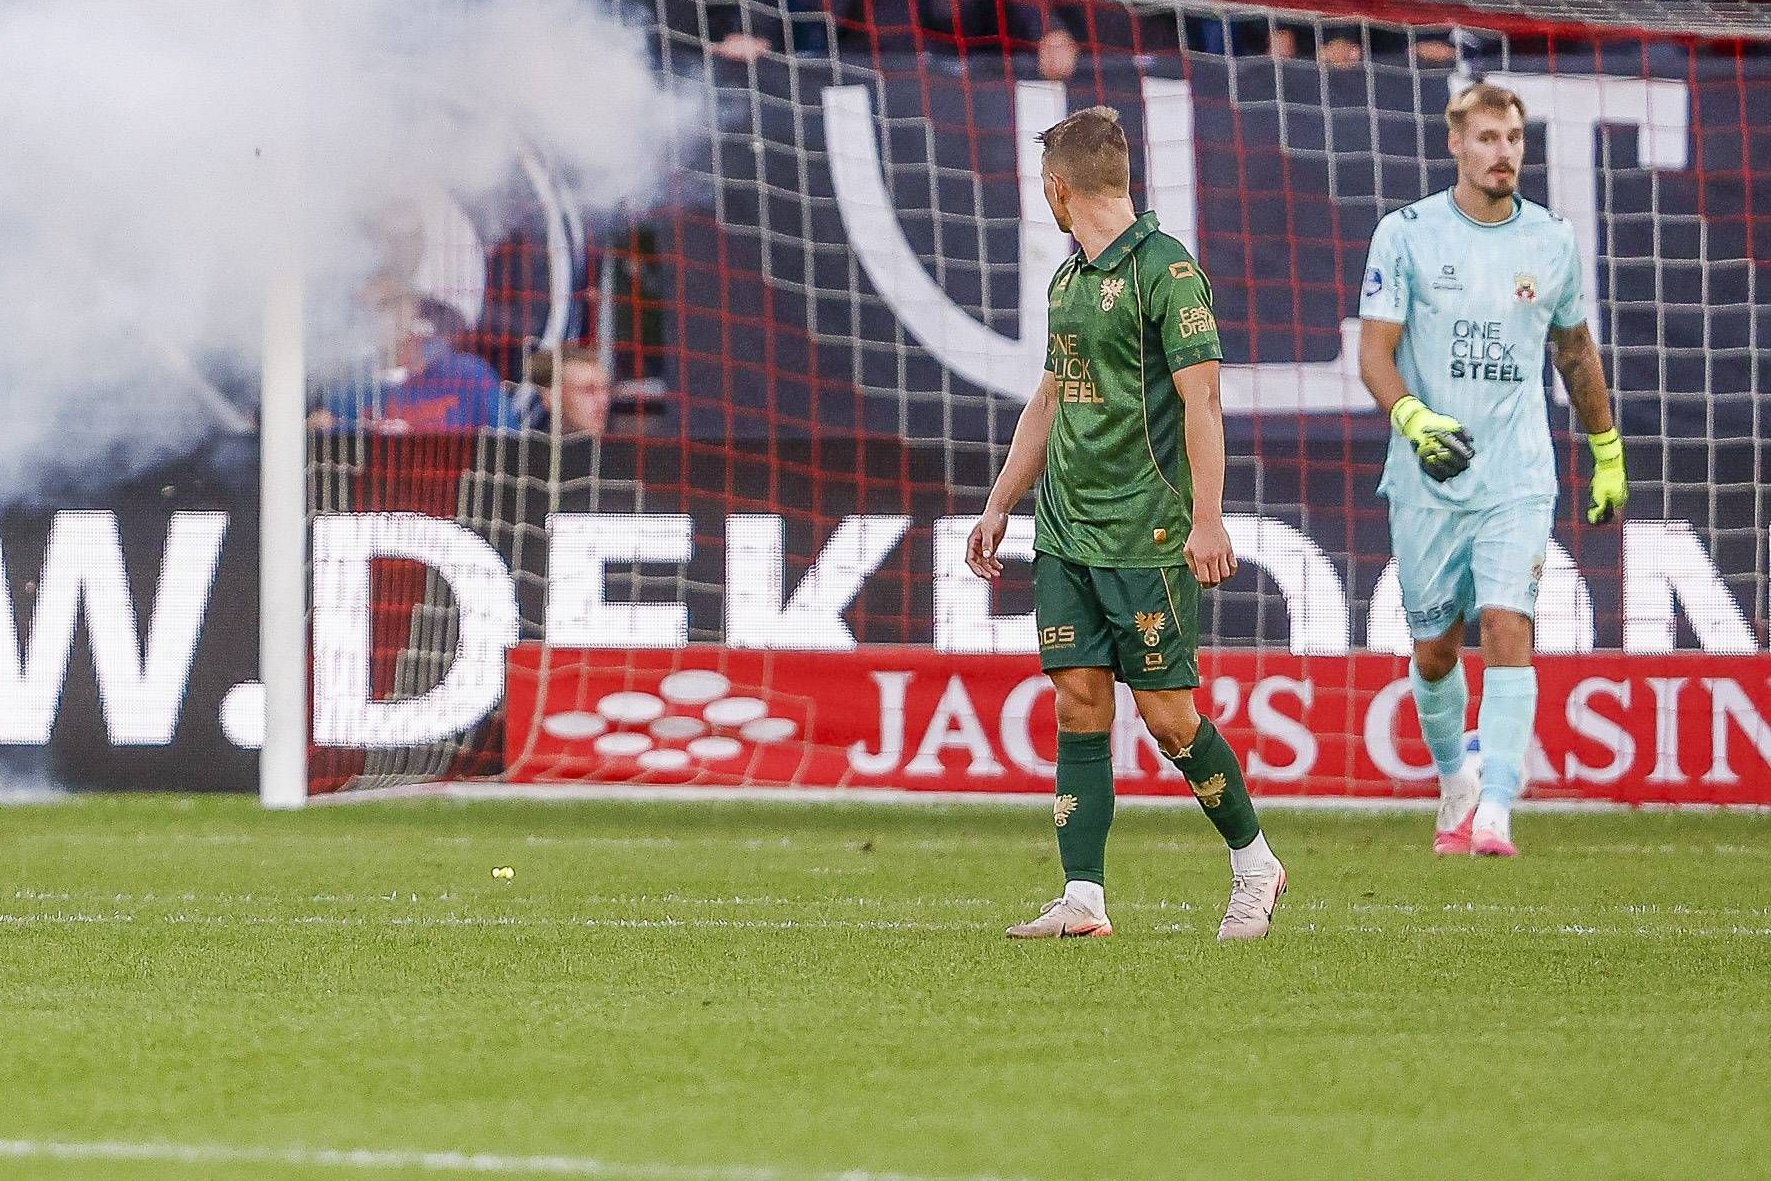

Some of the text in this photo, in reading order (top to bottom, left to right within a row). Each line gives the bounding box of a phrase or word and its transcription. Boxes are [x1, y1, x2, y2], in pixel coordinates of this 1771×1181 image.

[1452, 319, 1502, 340] ONE
[1451, 339, 1517, 362] CLICK
[1051, 358, 1092, 380] LICK
[1450, 360, 1525, 382] STEEL
[1058, 380, 1105, 403] EEL
[1038, 624, 1076, 645] GS
[1364, 677, 1771, 784] CSIN
